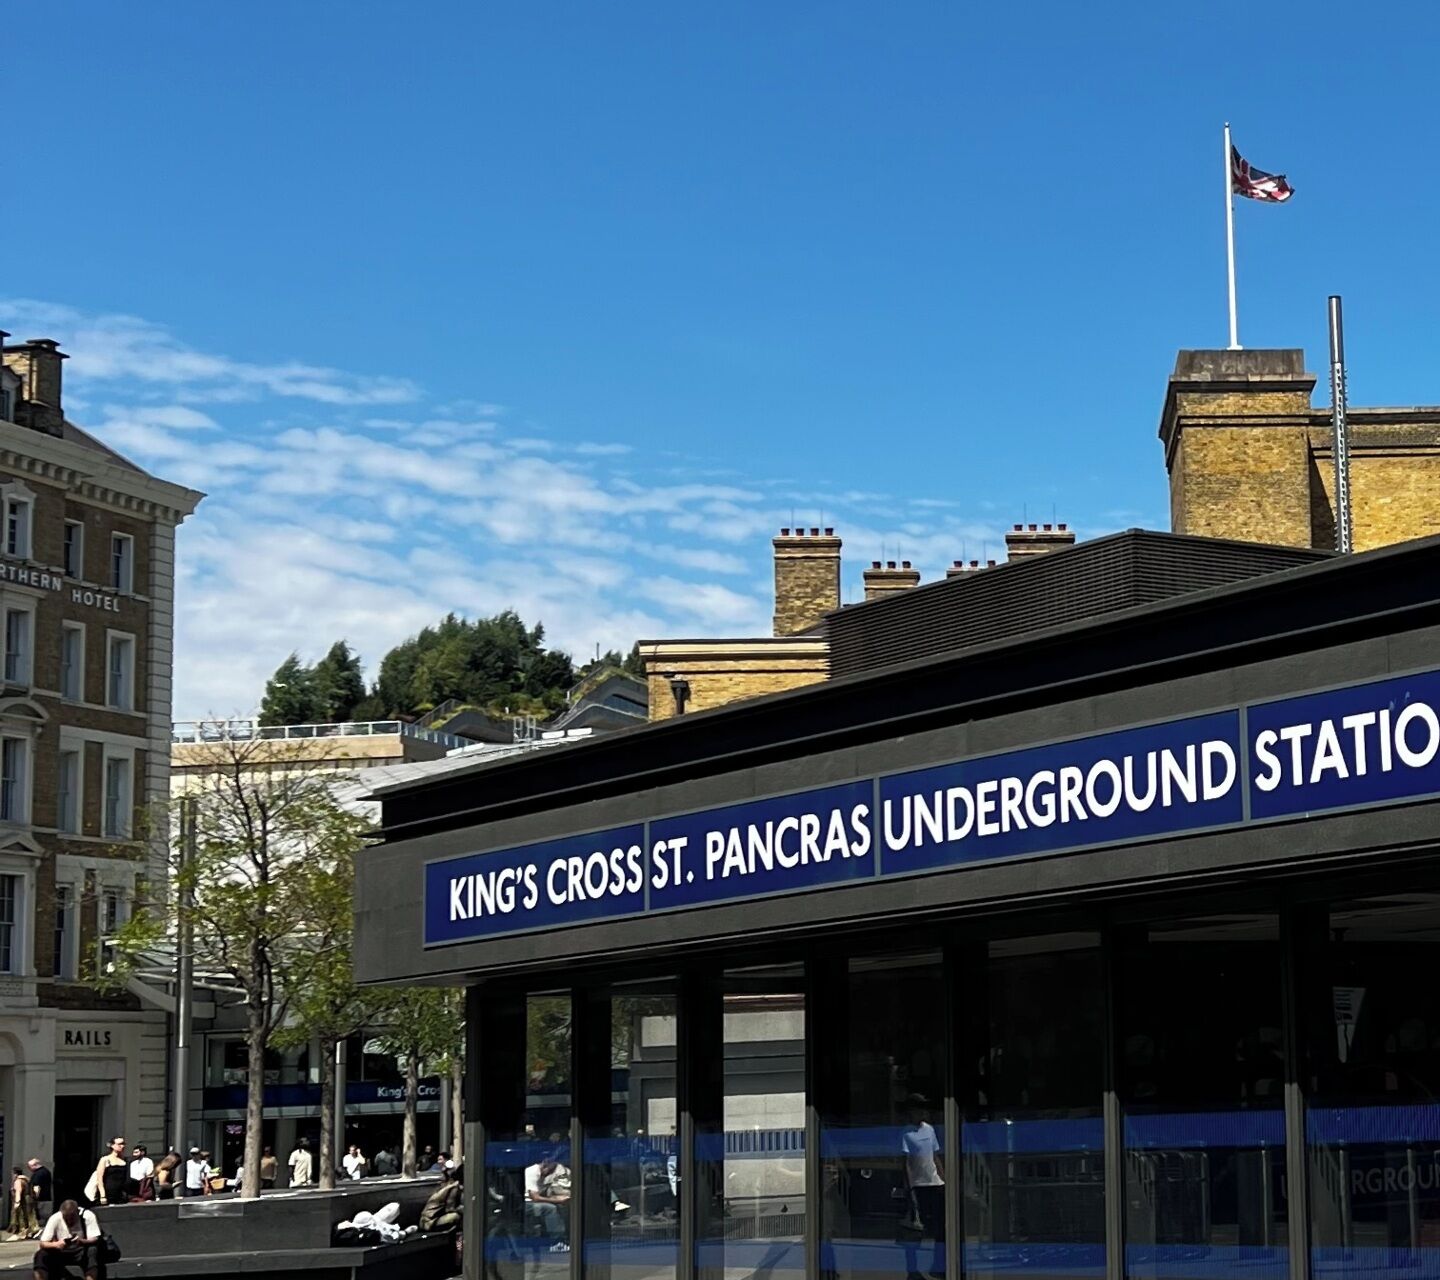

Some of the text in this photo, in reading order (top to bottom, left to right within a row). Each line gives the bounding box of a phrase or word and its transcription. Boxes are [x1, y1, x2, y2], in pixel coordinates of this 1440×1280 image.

[0, 563, 121, 612] RTHERN HOTEL
[546, 840, 643, 906] CROSS
[651, 836, 695, 889] ST.
[706, 803, 871, 881] PANCRAS
[883, 739, 1237, 851] UNDERGROUND
[64, 1029, 112, 1046] RAILS
